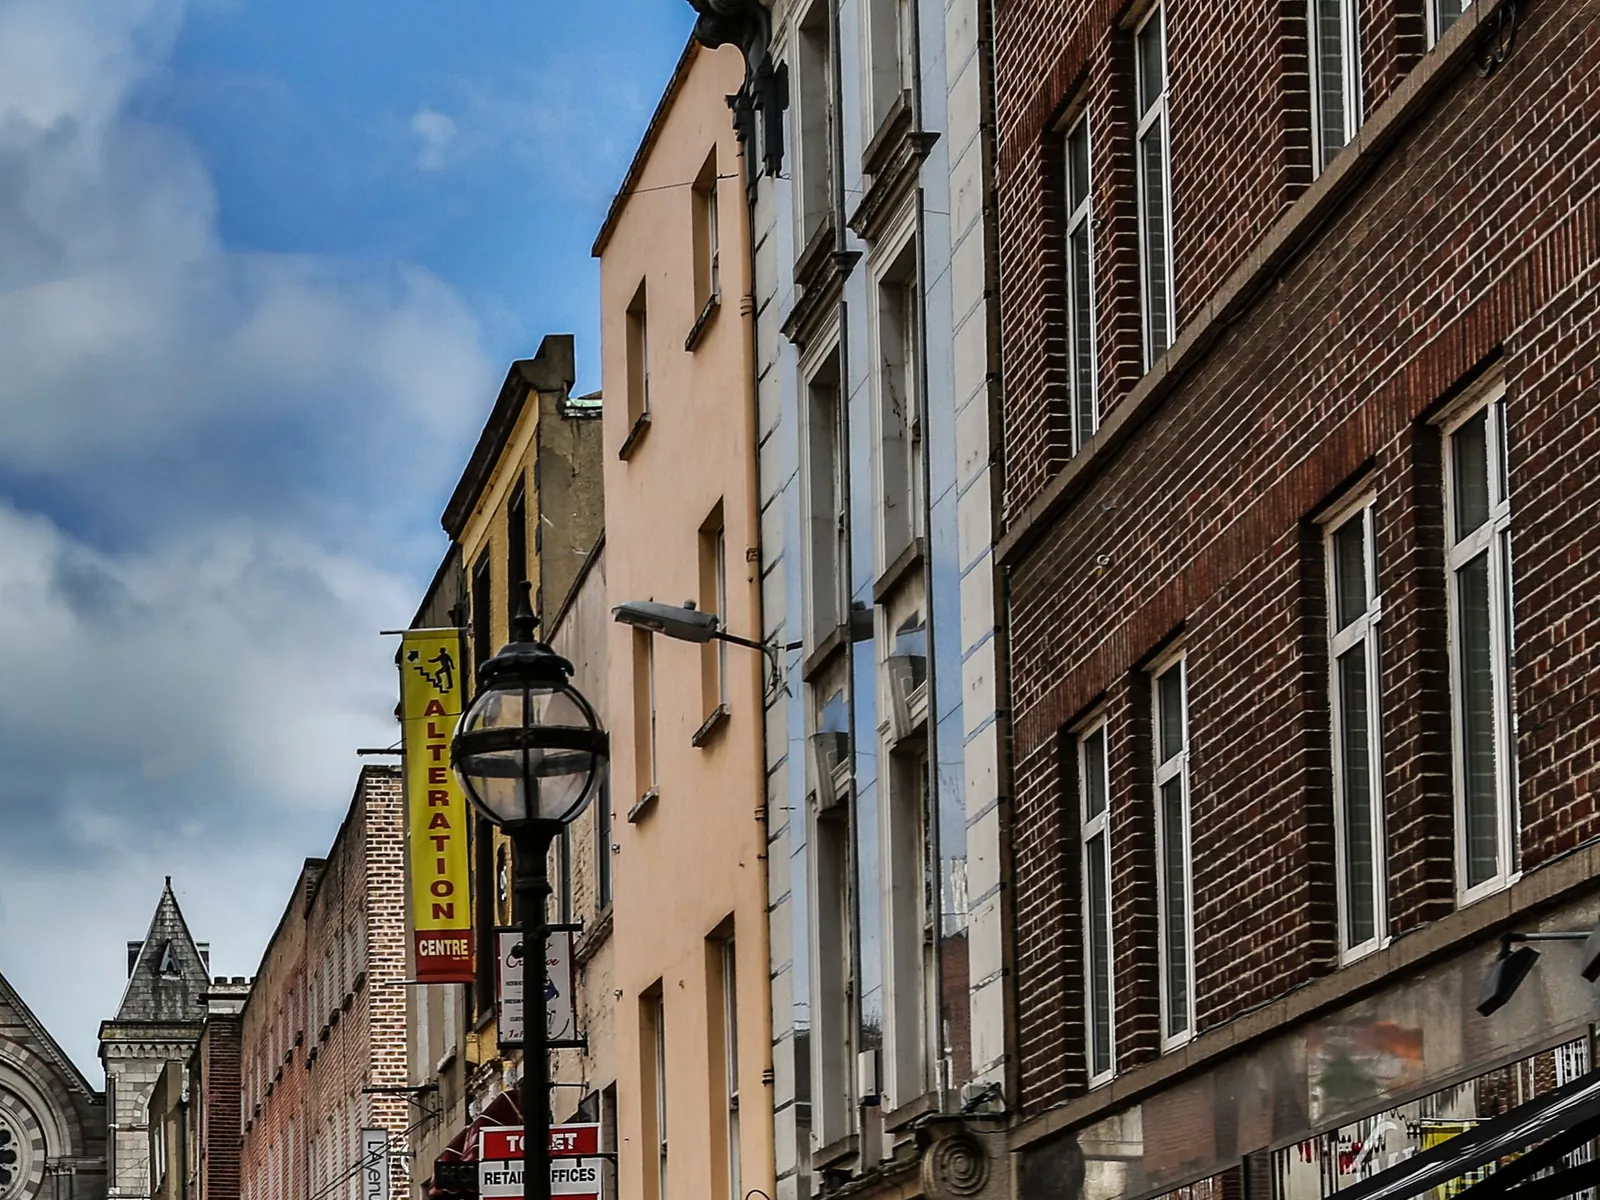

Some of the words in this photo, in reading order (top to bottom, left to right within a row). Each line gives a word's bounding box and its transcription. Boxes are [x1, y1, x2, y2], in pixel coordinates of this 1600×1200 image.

[423, 698, 455, 920] ALTERATION
[419, 938, 469, 957] CENTRE
[551, 1167, 596, 1182] FFICES
